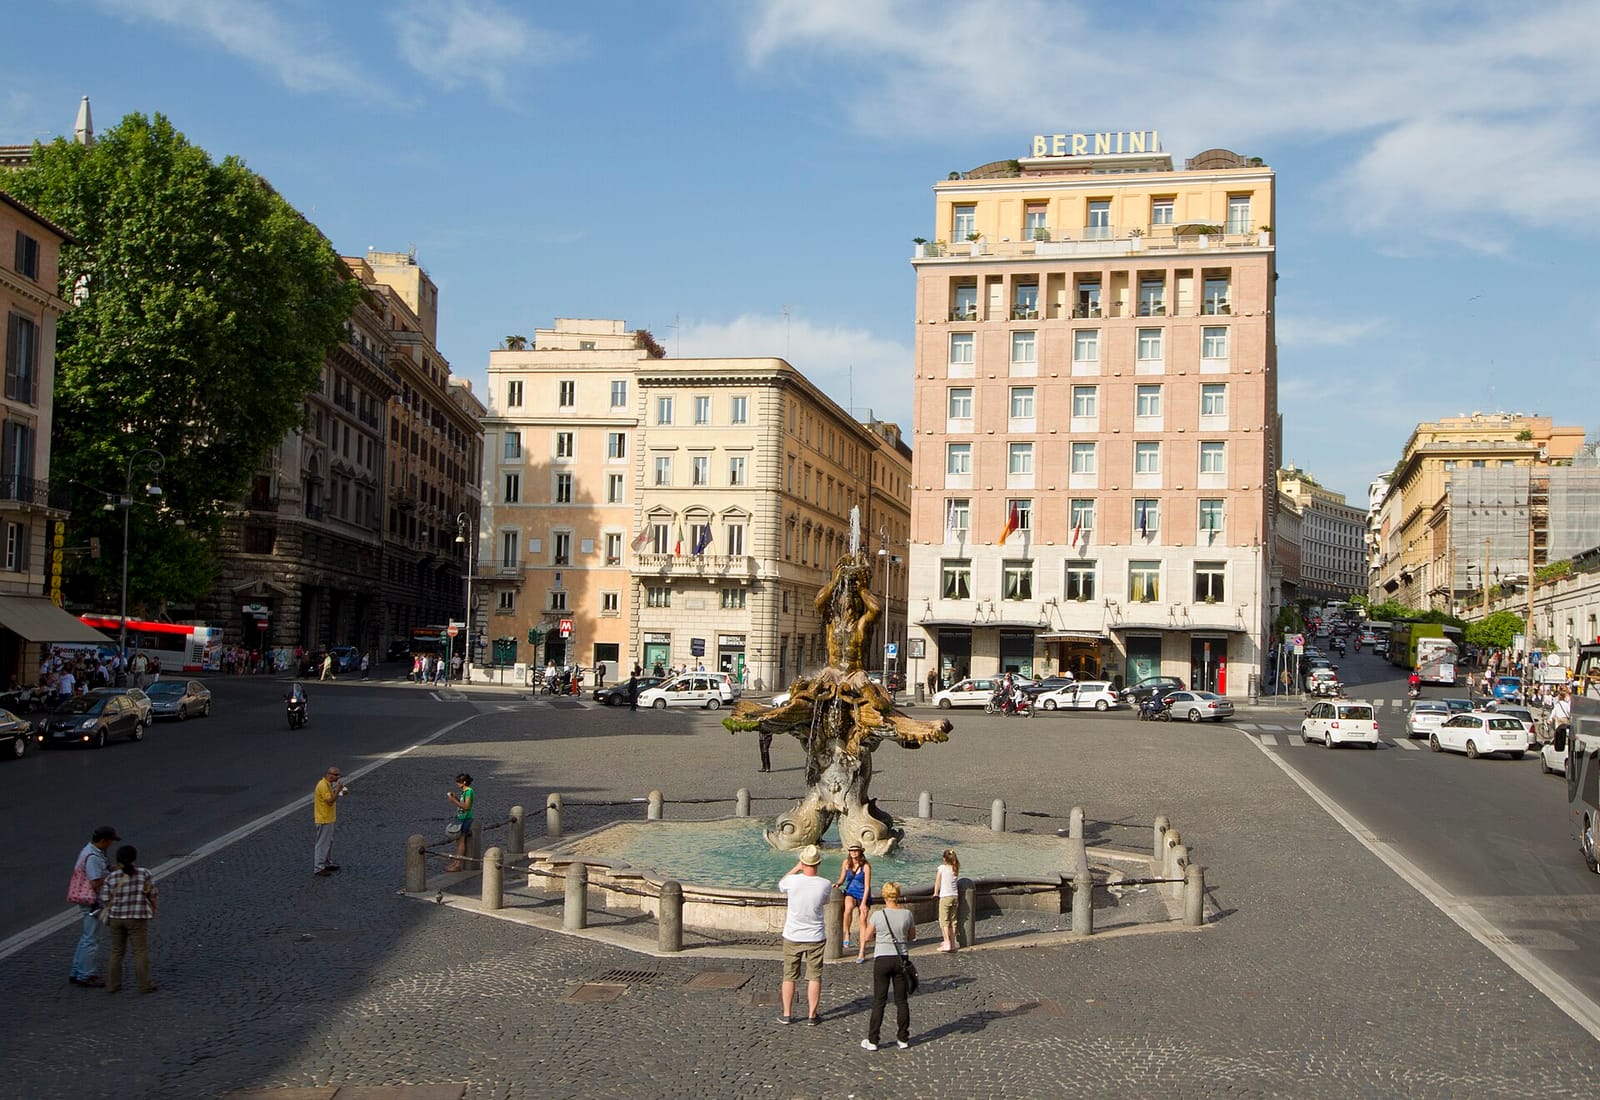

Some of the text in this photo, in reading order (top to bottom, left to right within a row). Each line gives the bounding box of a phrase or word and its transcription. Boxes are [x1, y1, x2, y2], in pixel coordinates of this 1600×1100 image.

[1033, 129, 1159, 157] BERNINI
[561, 621, 572, 630] M
[888, 644, 896, 653] P
